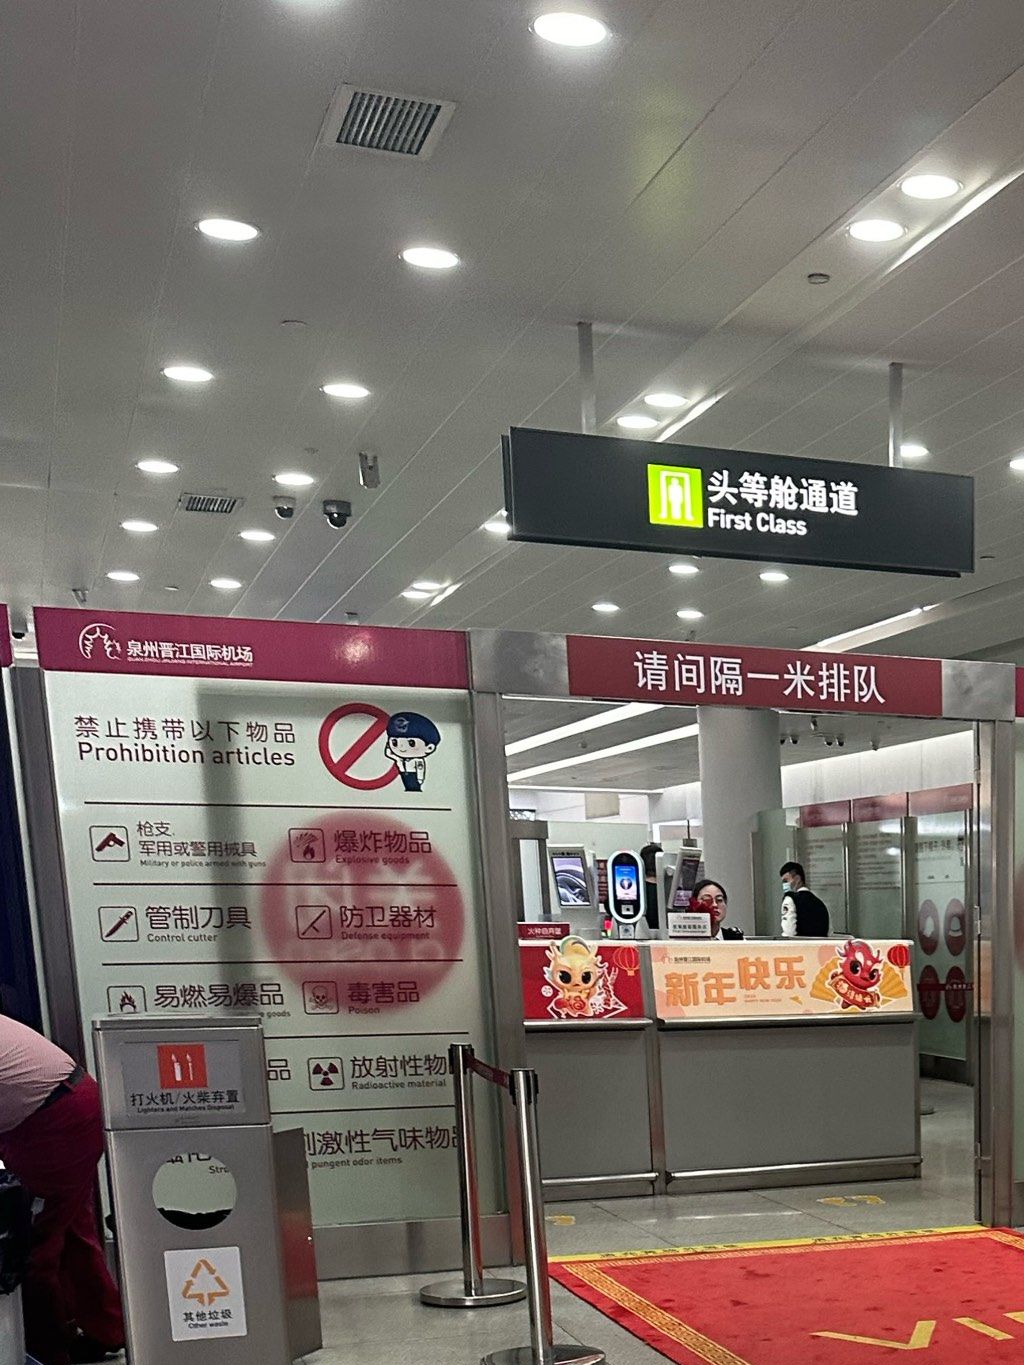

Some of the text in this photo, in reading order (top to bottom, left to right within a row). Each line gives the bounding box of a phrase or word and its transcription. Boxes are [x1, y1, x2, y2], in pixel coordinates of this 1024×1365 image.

[707, 469, 859, 517] 头等舱通道
[707, 507, 808, 536] First Class
[127, 640, 254, 662] 泉州晋江国际机场
[633, 649, 886, 704] 请间隔一米排队
[74, 714, 296, 744] 禁止携带以下物品
[78, 741, 295, 767] Prohibition articles
[139, 840, 258, 858] 军用或警用械具
[334, 829, 432, 854] 爆炸物品
[140, 860, 169, 868] Military
[181, 860, 204, 868] police
[335, 854, 410, 866] Explosive goods
[145, 905, 252, 930] 管制刀具
[339, 905, 437, 929] 防卫器材
[147, 933, 218, 943] Control cutter
[341, 931, 430, 942] Defense equipment
[347, 981, 420, 1004] 毒害品
[664, 956, 807, 1007] 新年快乐
[153, 983, 284, 1009] 易燃易爆品
[348, 1006, 381, 1015] Poison
[350, 1054, 447, 1079] 放射性物
[351, 1079, 447, 1091] Radioactive material
[130, 1089, 240, 1107] 打火机/火柴弃置
[311, 1159, 350, 1170] pungent
[352, 1158, 373, 1166] odor
[376, 1156, 403, 1166] items
[183, 1308, 233, 1322] 其他垃圾
